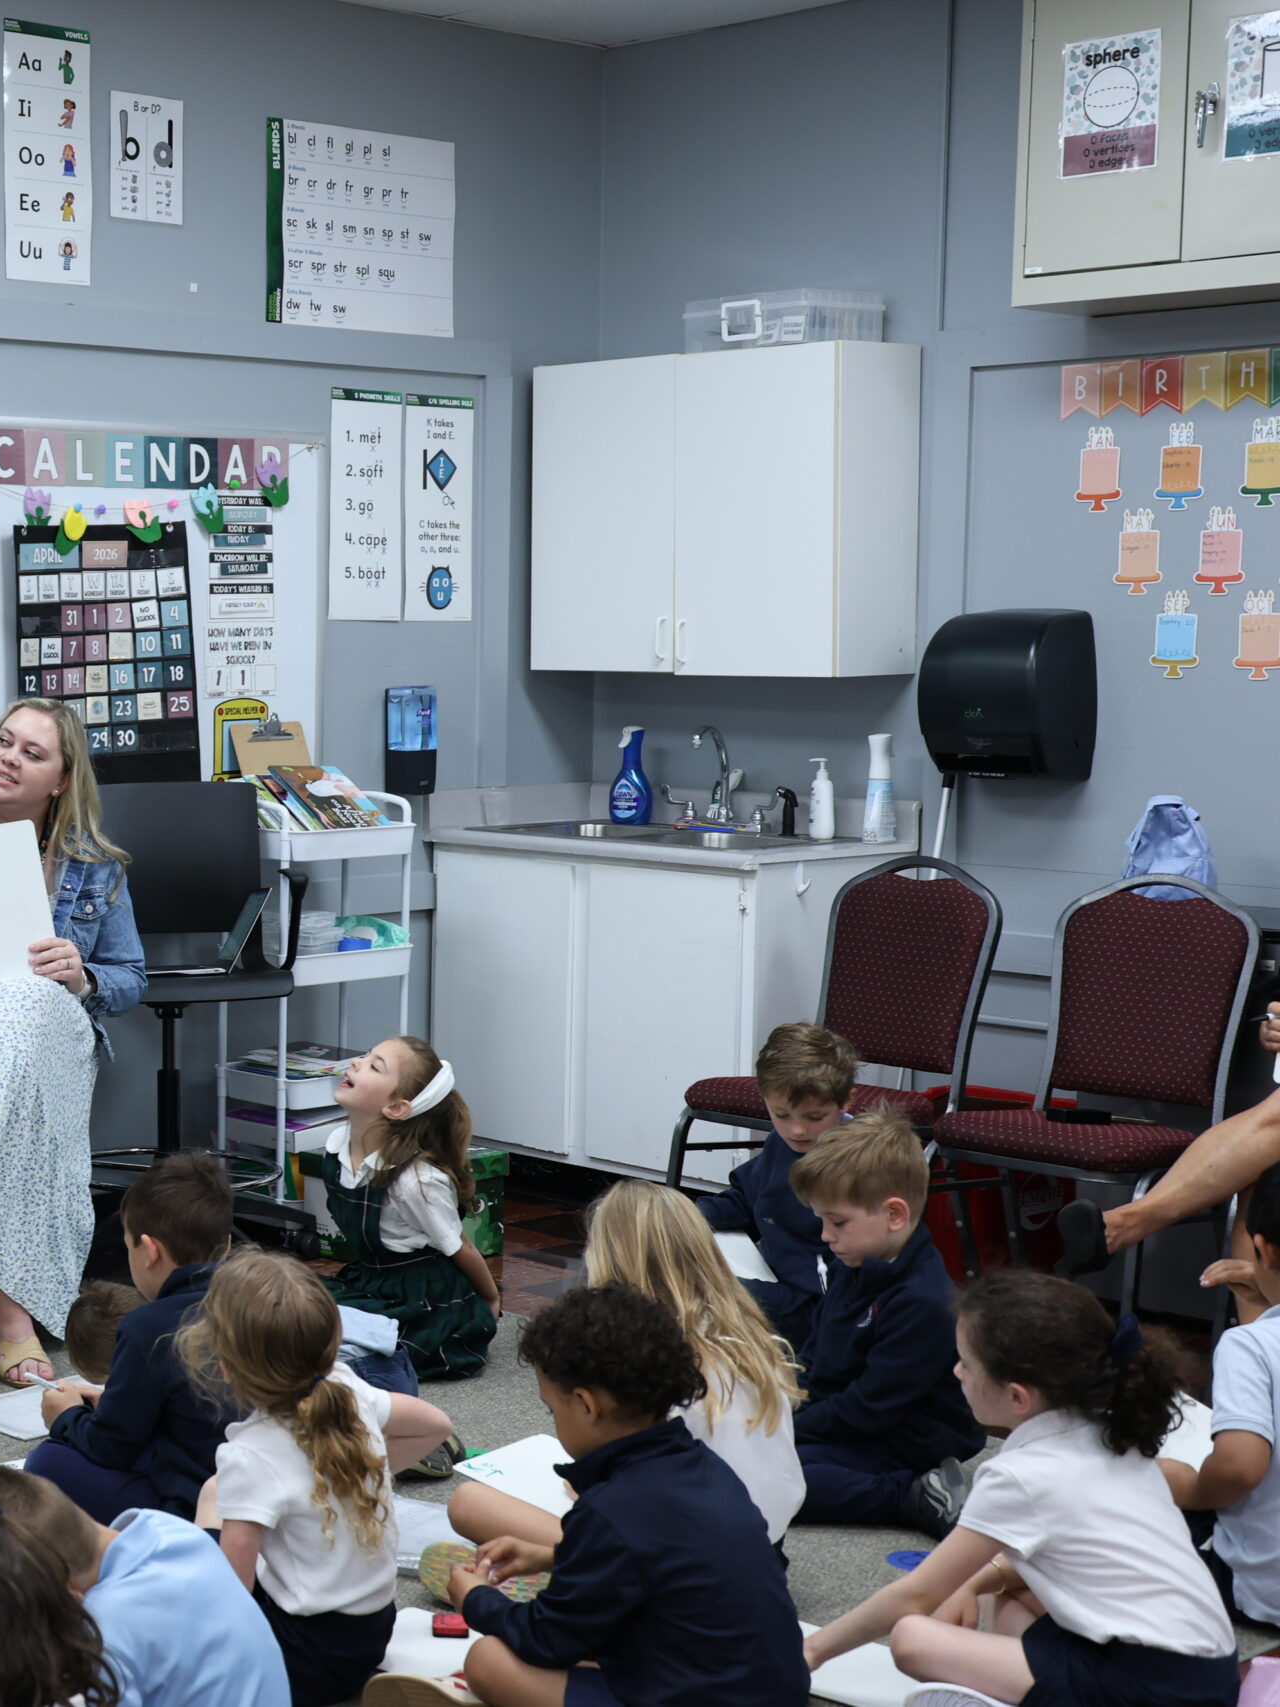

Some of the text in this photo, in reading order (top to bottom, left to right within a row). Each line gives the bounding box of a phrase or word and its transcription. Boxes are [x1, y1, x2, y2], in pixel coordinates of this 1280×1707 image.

[65, 30, 89, 41] VOWELS
[18, 51, 42, 72] Aa
[1085, 46, 1140, 69] sphere
[18, 98, 31, 117] Ii
[151, 103, 161, 115] D?
[271, 121, 281, 169] BLENDS
[288, 132, 391, 157] bl cl gl pl sl
[1092, 142, 1136, 157] vertices
[19, 146, 45, 168] Oo
[288, 173, 392, 200] br cr dr fr gr pr
[19, 193, 41, 212] Ee
[286, 217, 432, 242] sc sk sm sn sp st sw
[19, 240, 43, 261] Uu
[288, 259, 395, 280] scr spr str spl squ
[286, 298, 347, 314] dw tw sw
[434, 419, 454, 428] takes
[432, 431, 447, 440] and
[1086, 433, 1114, 449] JAN
[345, 464, 357, 477] 2.
[345, 498, 356, 512] 3.
[426, 520, 460, 530] takes the
[1208, 514, 1236, 529] JUN
[345, 532, 356, 545] 4.
[418, 532, 438, 542] other
[94, 549, 118, 561] 2026
[438, 545, 452, 554] and
[227, 564, 259, 573] SATURDAY
[344, 567, 355, 580] 5.
[66, 607, 124, 626] 31 2
[139, 606, 150, 614] NO
[170, 606, 179, 621] 4
[208, 627, 273, 638] HOW MANY DAYS
[140, 633, 183, 652] 10 11
[209, 641, 229, 652] HAVE
[230, 641, 242, 651] WE
[262, 640, 272, 650] IN
[24, 665, 184, 692] 12 13 14 16 17 18
[114, 696, 190, 717] 23 25
[224, 706, 259, 715] SPECIAL HELPER
[92, 729, 136, 748] 29 30
